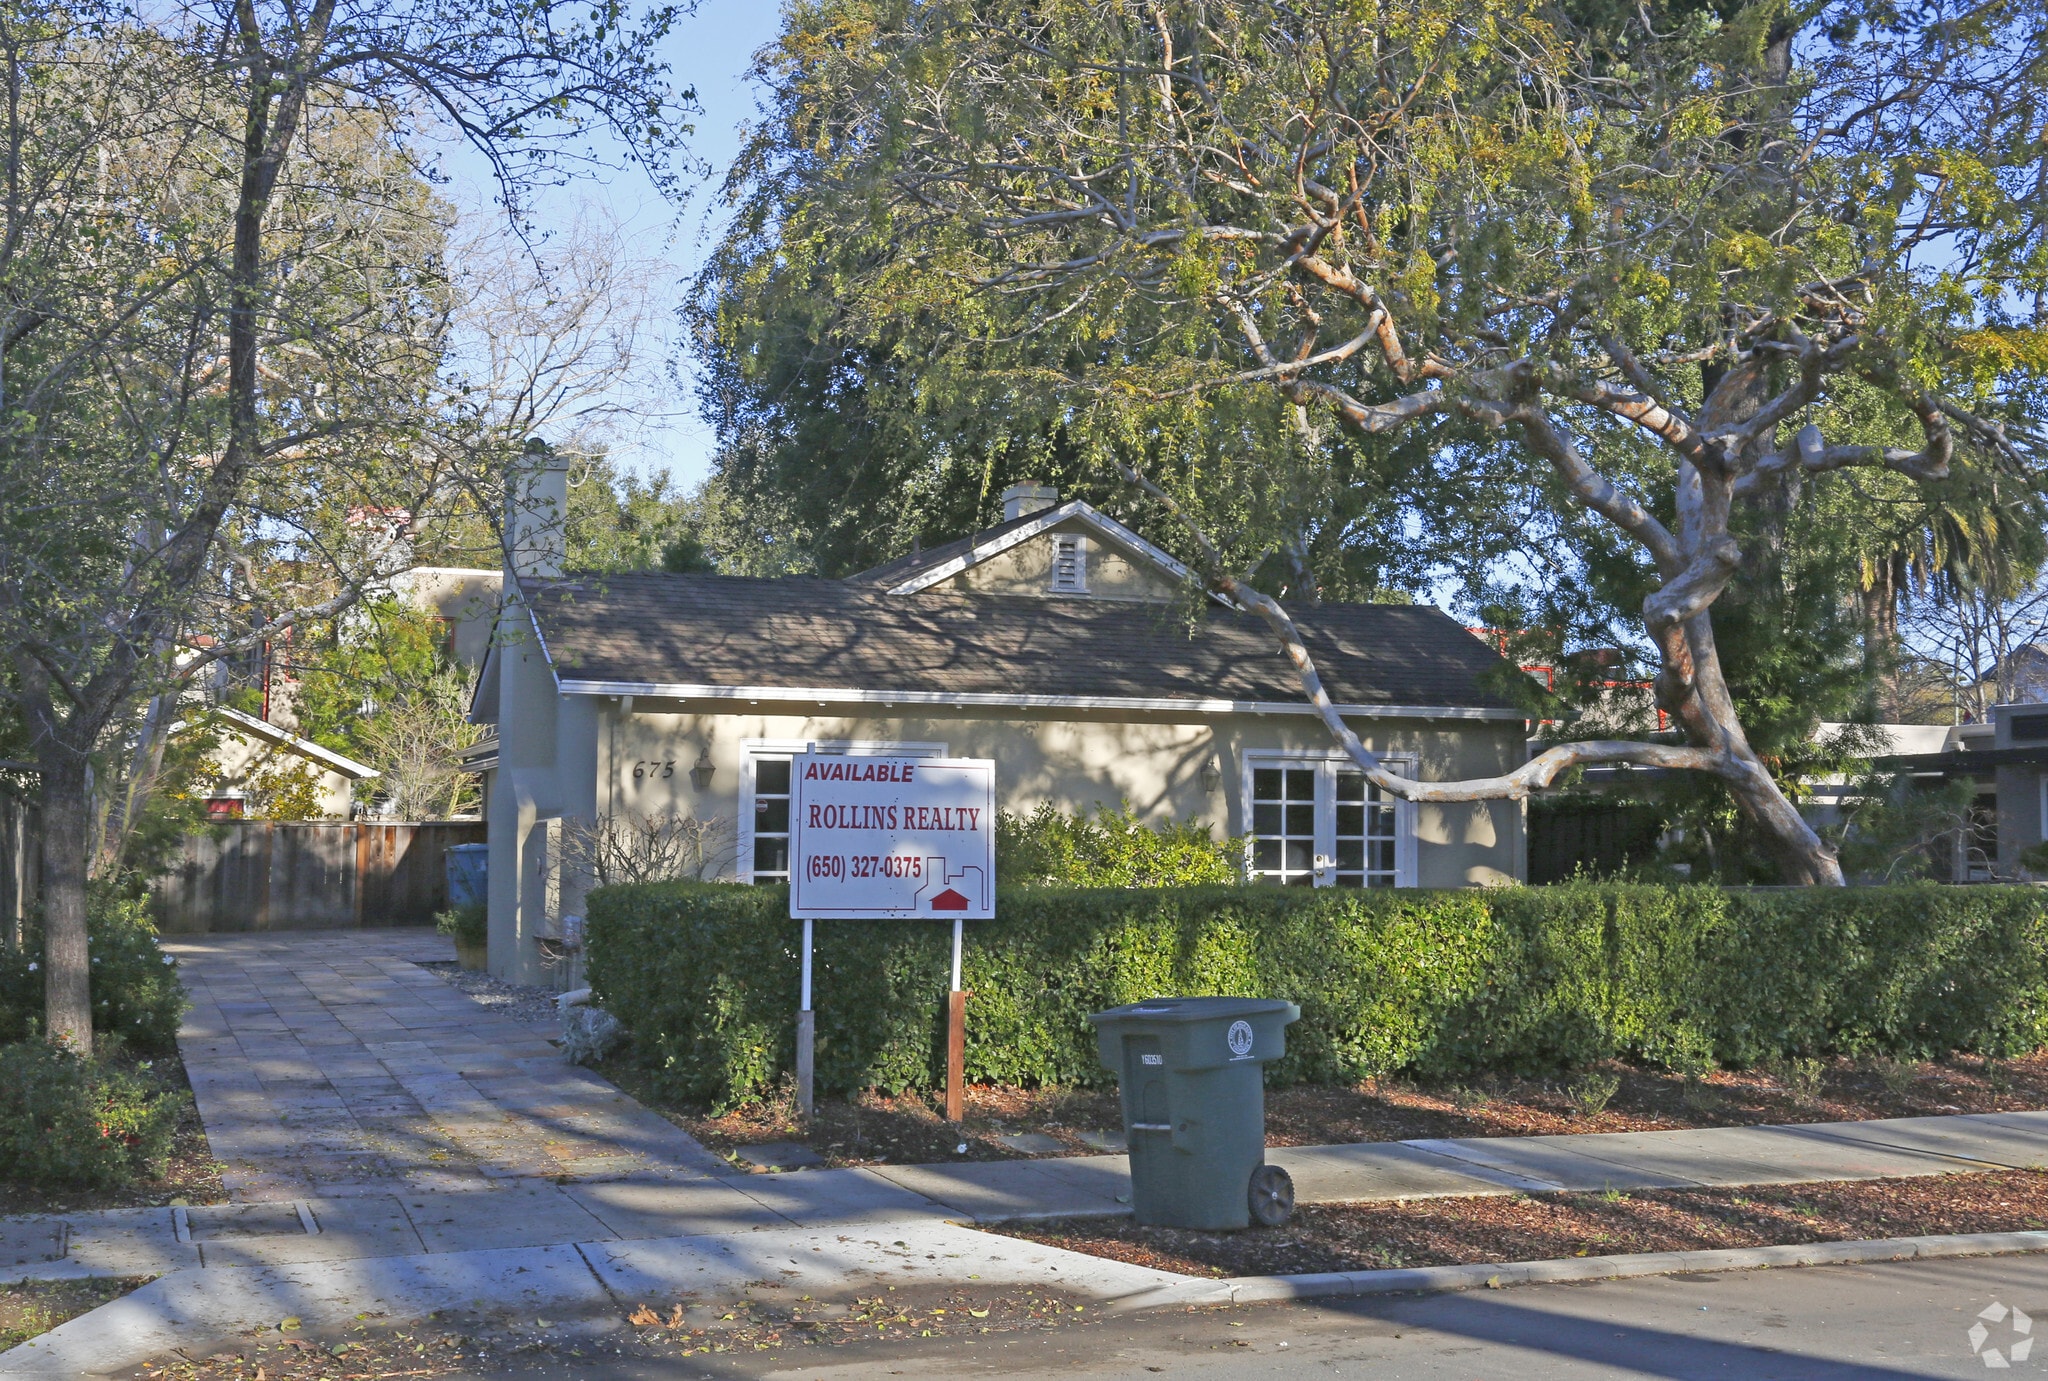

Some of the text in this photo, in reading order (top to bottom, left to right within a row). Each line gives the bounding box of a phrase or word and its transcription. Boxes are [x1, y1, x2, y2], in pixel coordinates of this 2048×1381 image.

[633, 760, 677, 779] 675
[804, 762, 914, 783] AVAILABLE
[808, 804, 981, 831] ROLLINS REALTY
[806, 855, 922, 883] (650) 327-0375
